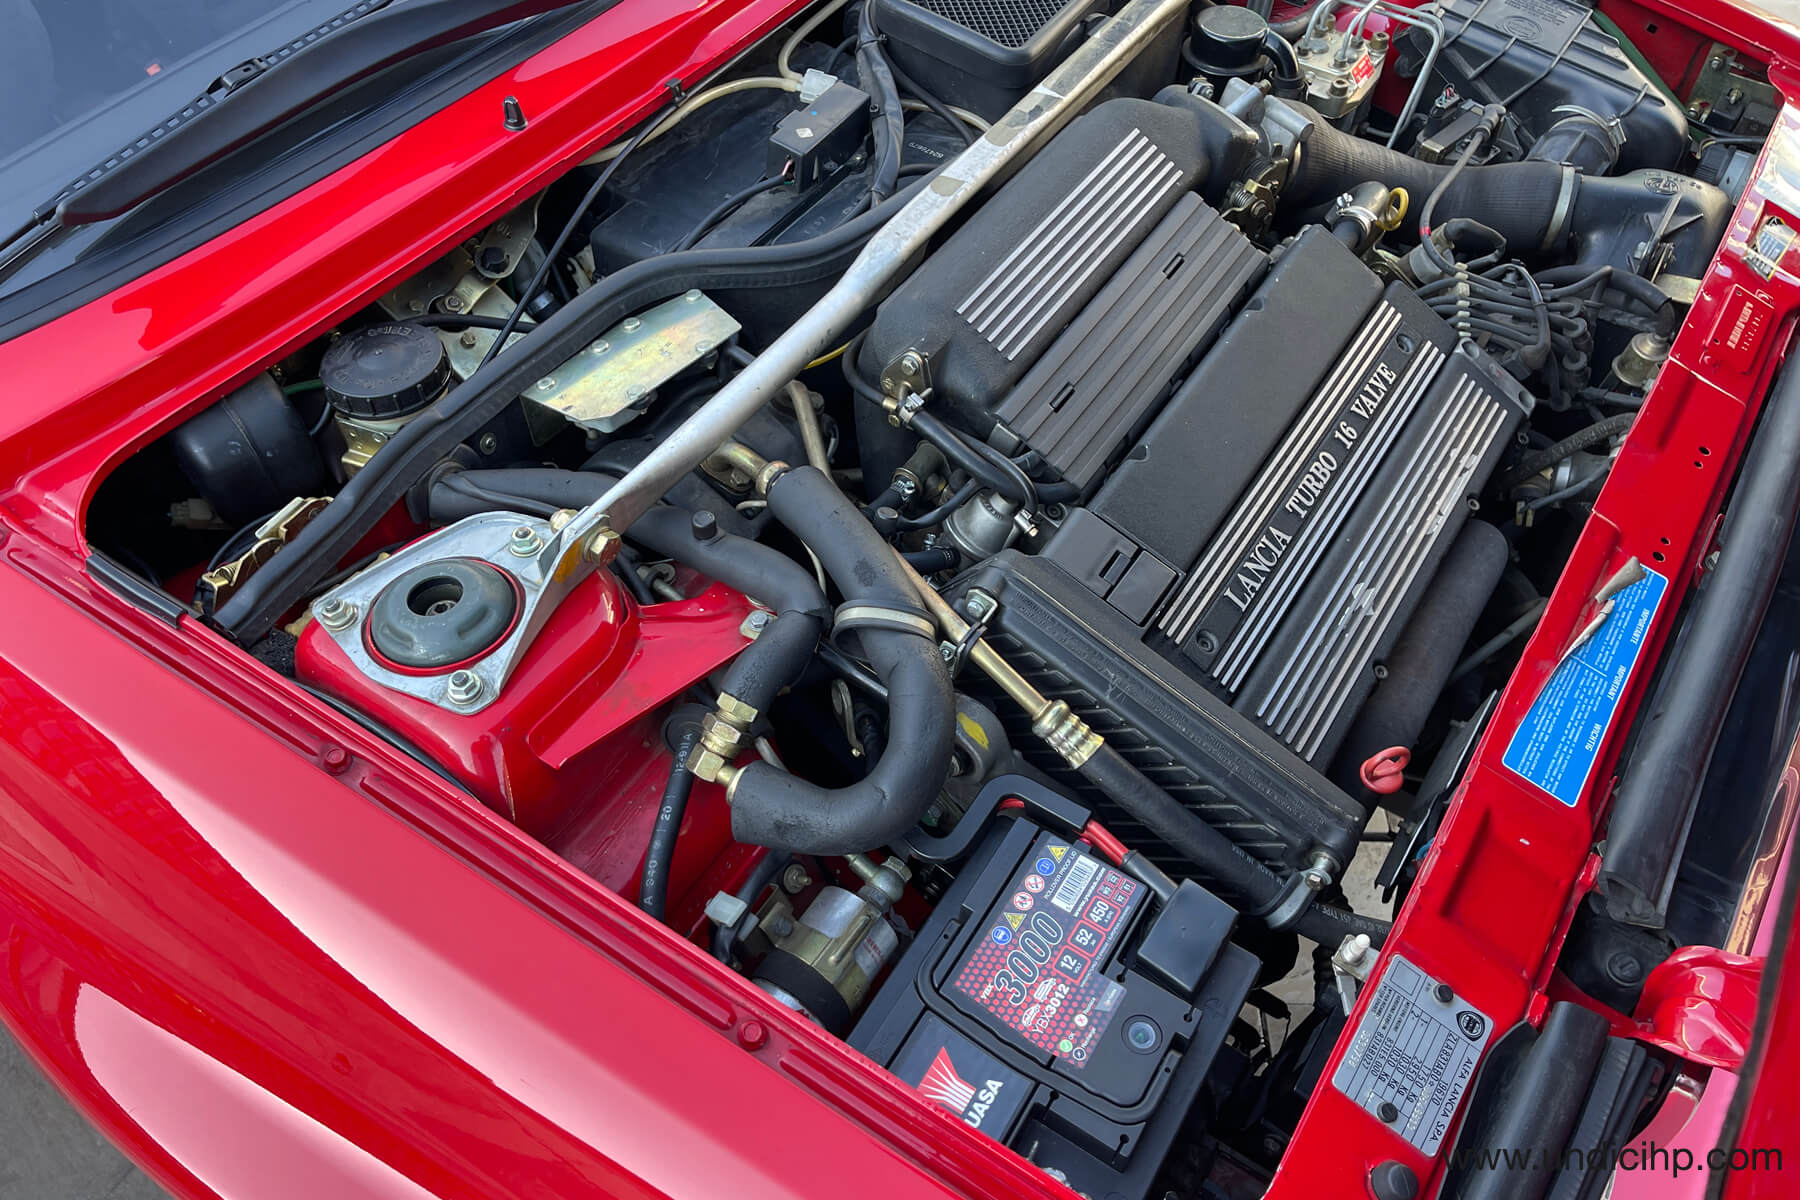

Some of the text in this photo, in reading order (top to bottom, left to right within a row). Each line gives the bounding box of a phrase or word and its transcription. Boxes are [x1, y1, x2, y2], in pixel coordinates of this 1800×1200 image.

[1223, 362, 1397, 612] LANCIA TURBO 16 VALVE
[1630, 608, 1650, 645] IMPORTANTE
[1607, 665, 1626, 701] IMPORTANT
[1585, 723, 1602, 752] WICHTIG
[660, 805, 672, 821] 20
[1043, 874, 1062, 900] ROLLOVER
[1073, 867, 1106, 917] www.yuasa.com
[1089, 900, 1109, 923] 450
[1075, 928, 1093, 946] 52
[994, 910, 1065, 1007] 3000
[1060, 954, 1077, 970] 12
[1073, 962, 1082, 974] VOLT
[980, 982, 994, 1000] YBX
[1031, 983, 1070, 1034] YBX3012
[1370, 1035, 1394, 1077] 831E5.000
[1384, 1044, 1402, 1068] 1030
[1394, 1051, 1412, 1075] 1030
[1403, 1054, 1422, 1082] 2950
[1458, 1056, 1473, 1079] ALFA
[1376, 1069, 1390, 1083] Kg
[1386, 1076, 1400, 1090] Kg
[1412, 1063, 1431, 1089] 1750
[1395, 1083, 1409, 1096] Kg
[1405, 1090, 1418, 1103] Kg
[1429, 1078, 1449, 1106] 19670
[1441, 1082, 1462, 1118] LANCIA
